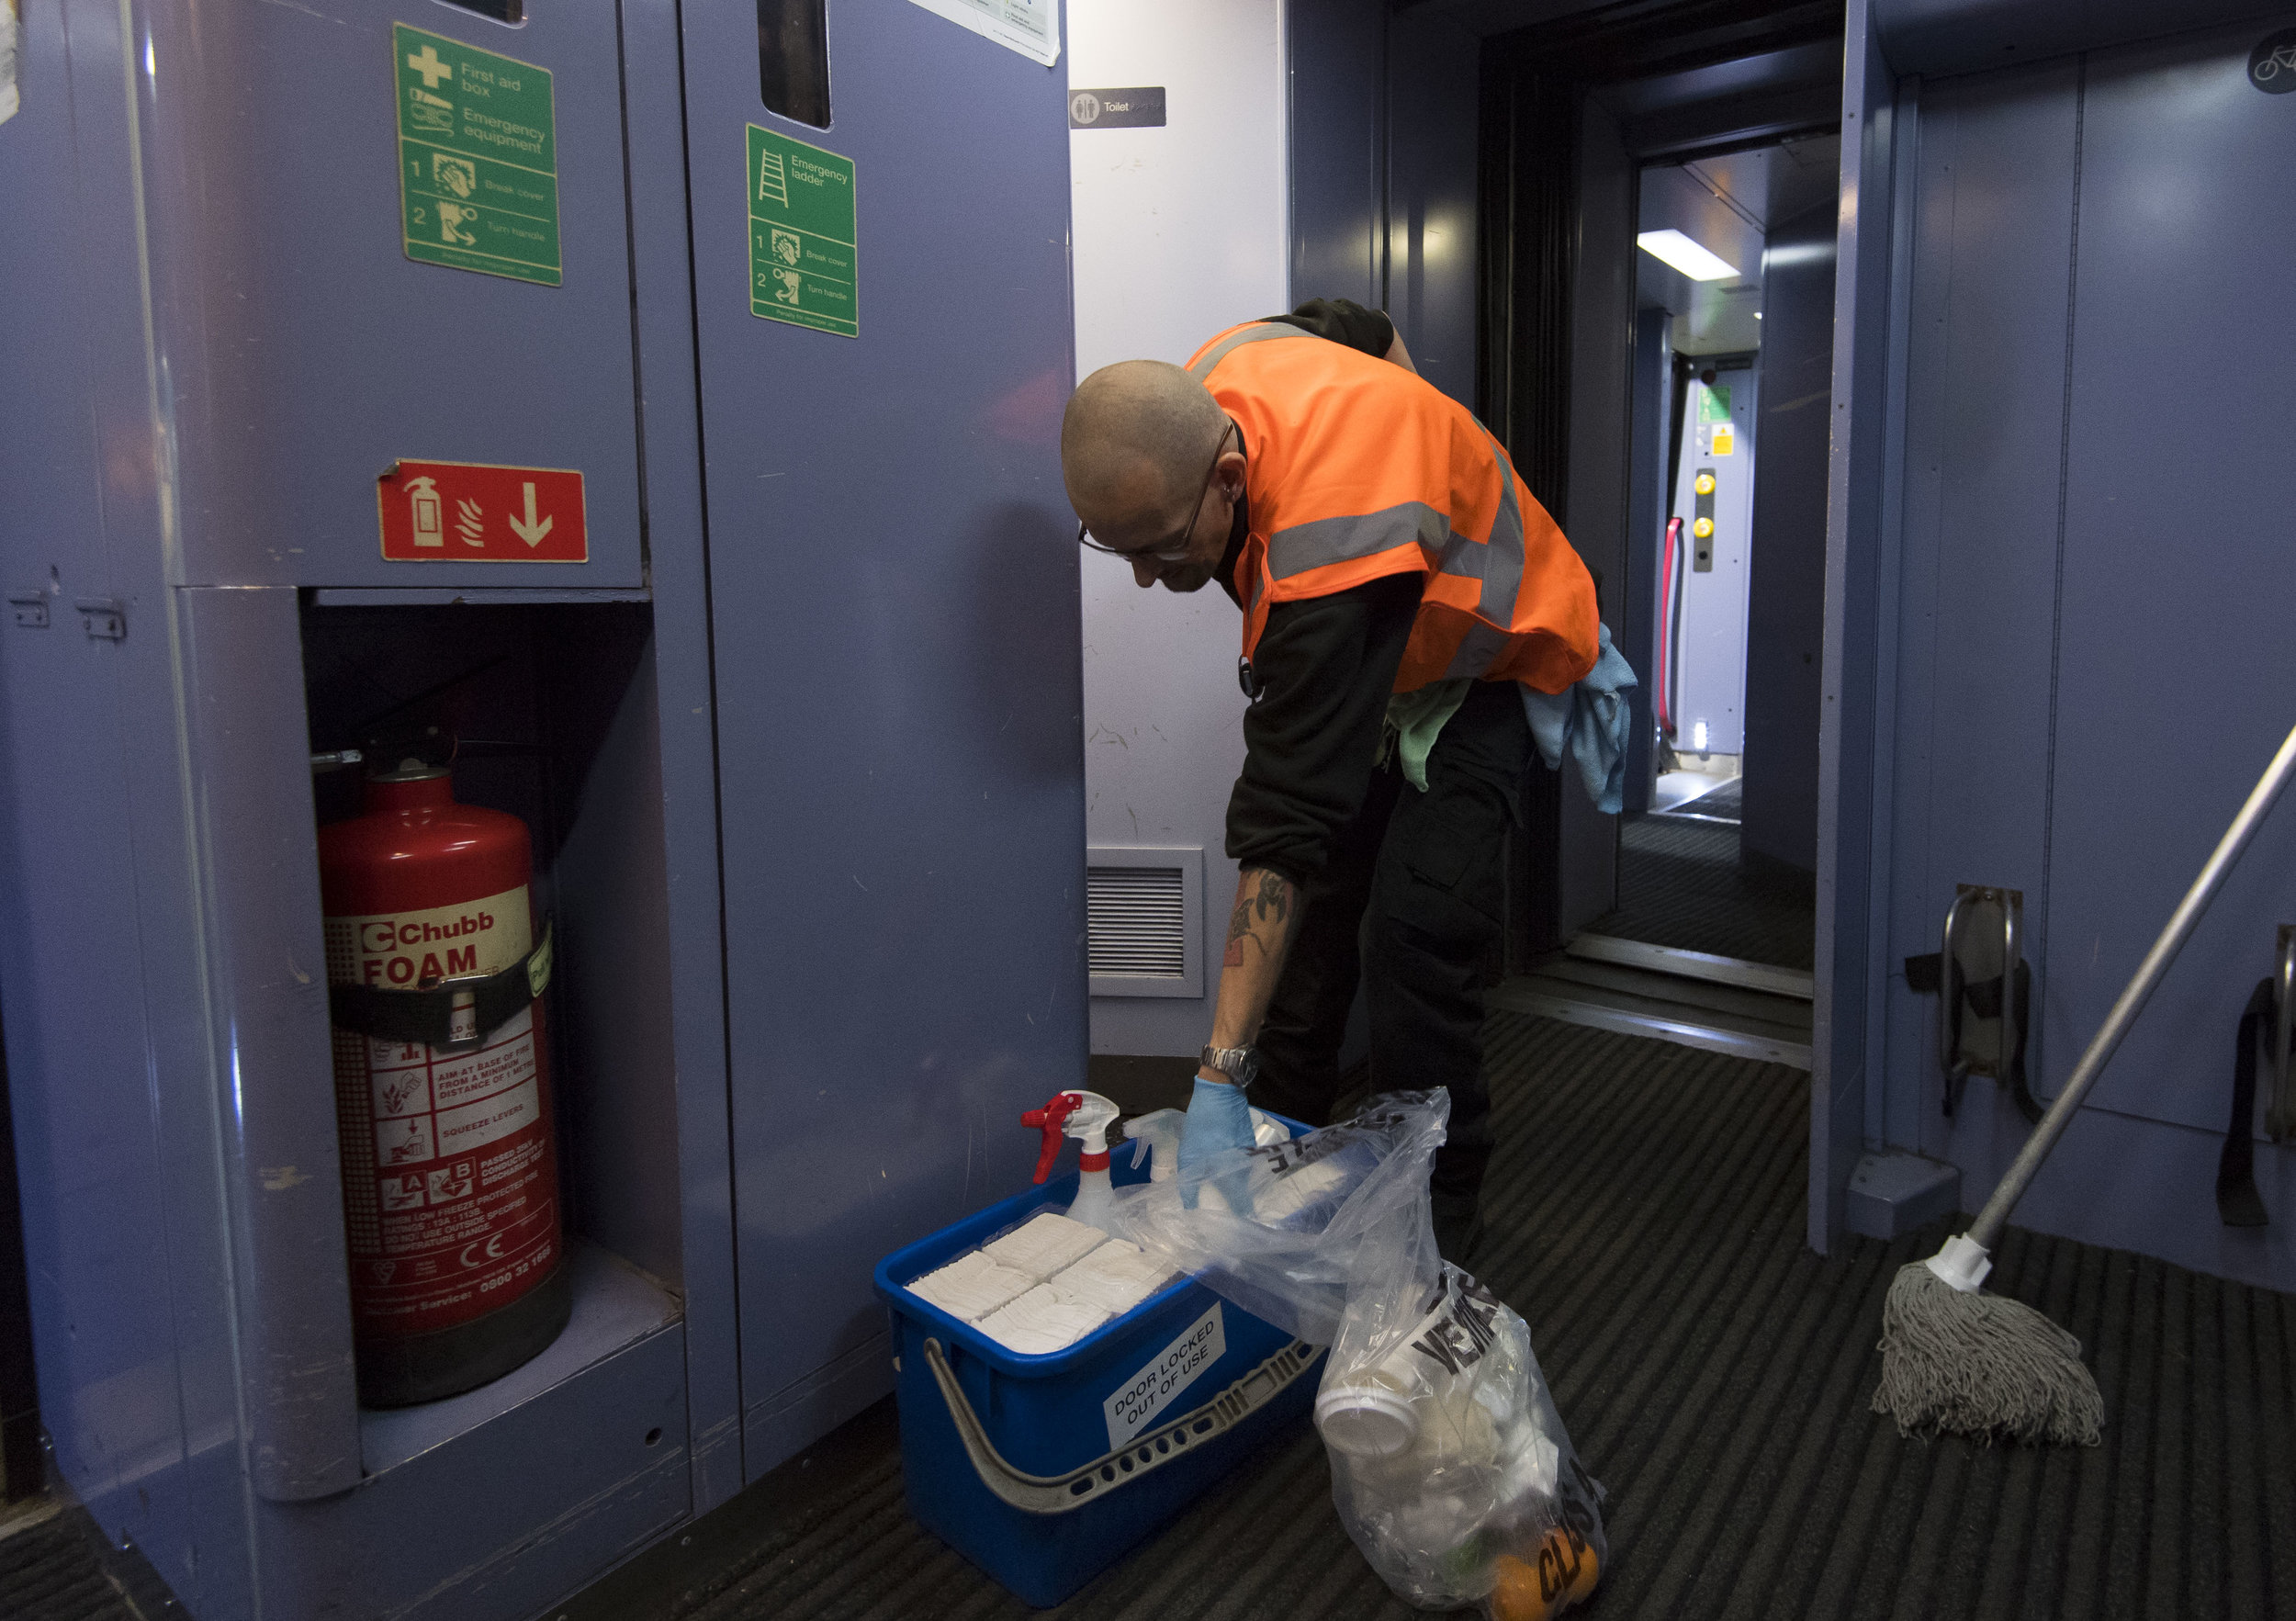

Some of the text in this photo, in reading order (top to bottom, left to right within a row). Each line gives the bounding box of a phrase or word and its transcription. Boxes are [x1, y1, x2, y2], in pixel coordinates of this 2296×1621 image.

[461, 62, 522, 92] First aid
[462, 79, 490, 97] box
[1104, 102, 1129, 112] Toilet
[463, 107, 546, 143] Emergency
[463, 125, 542, 154] equipment
[411, 161, 420, 177] 1
[792, 154, 848, 185] Emergency
[792, 168, 825, 187] ladder
[485, 179, 545, 201] Break cover
[412, 207, 426, 225] 2
[488, 220, 546, 242] Turn handle
[757, 235, 764, 249] 1
[806, 250, 848, 268] Break cover
[758, 273, 766, 287] 2
[807, 284, 848, 301] Turn handle
[399, 912, 495, 946] Chubb
[364, 944, 478, 985] FOAM
[439, 1043, 530, 1081] AIM AT BASE OF FIRE
[439, 1058, 519, 1090] FROM A MINIMUM
[439, 1079, 490, 1099] DISTANCE
[492, 1075, 504, 1083] OF
[443, 1103, 523, 1138] SQUEEZE LEVERS
[456, 1163, 471, 1177] B
[480, 1149, 515, 1168] PASSED
[481, 1144, 538, 1177] CONDUCTIVITY
[407, 1175, 422, 1189] A
[482, 1158, 530, 1186] DISCHARGE
[413, 1211, 435, 1221] LOW
[437, 1200, 475, 1217] FREEZE
[477, 1179, 524, 1205] PROTECTED
[422, 1227, 443, 1239] USE
[445, 1215, 486, 1233] OUTSIDE
[487, 1196, 527, 1220] SPECIFIED
[433, 1217, 451, 1228] 13A
[385, 1233, 456, 1254] TEMPERATURE
[420, 1290, 473, 1311] Service:
[479, 1272, 512, 1293] 0800
[515, 1262, 530, 1277] 32
[1114, 1321, 1214, 1416] DOOR LOCKED
[1128, 1344, 1210, 1424] OUT OF USE
